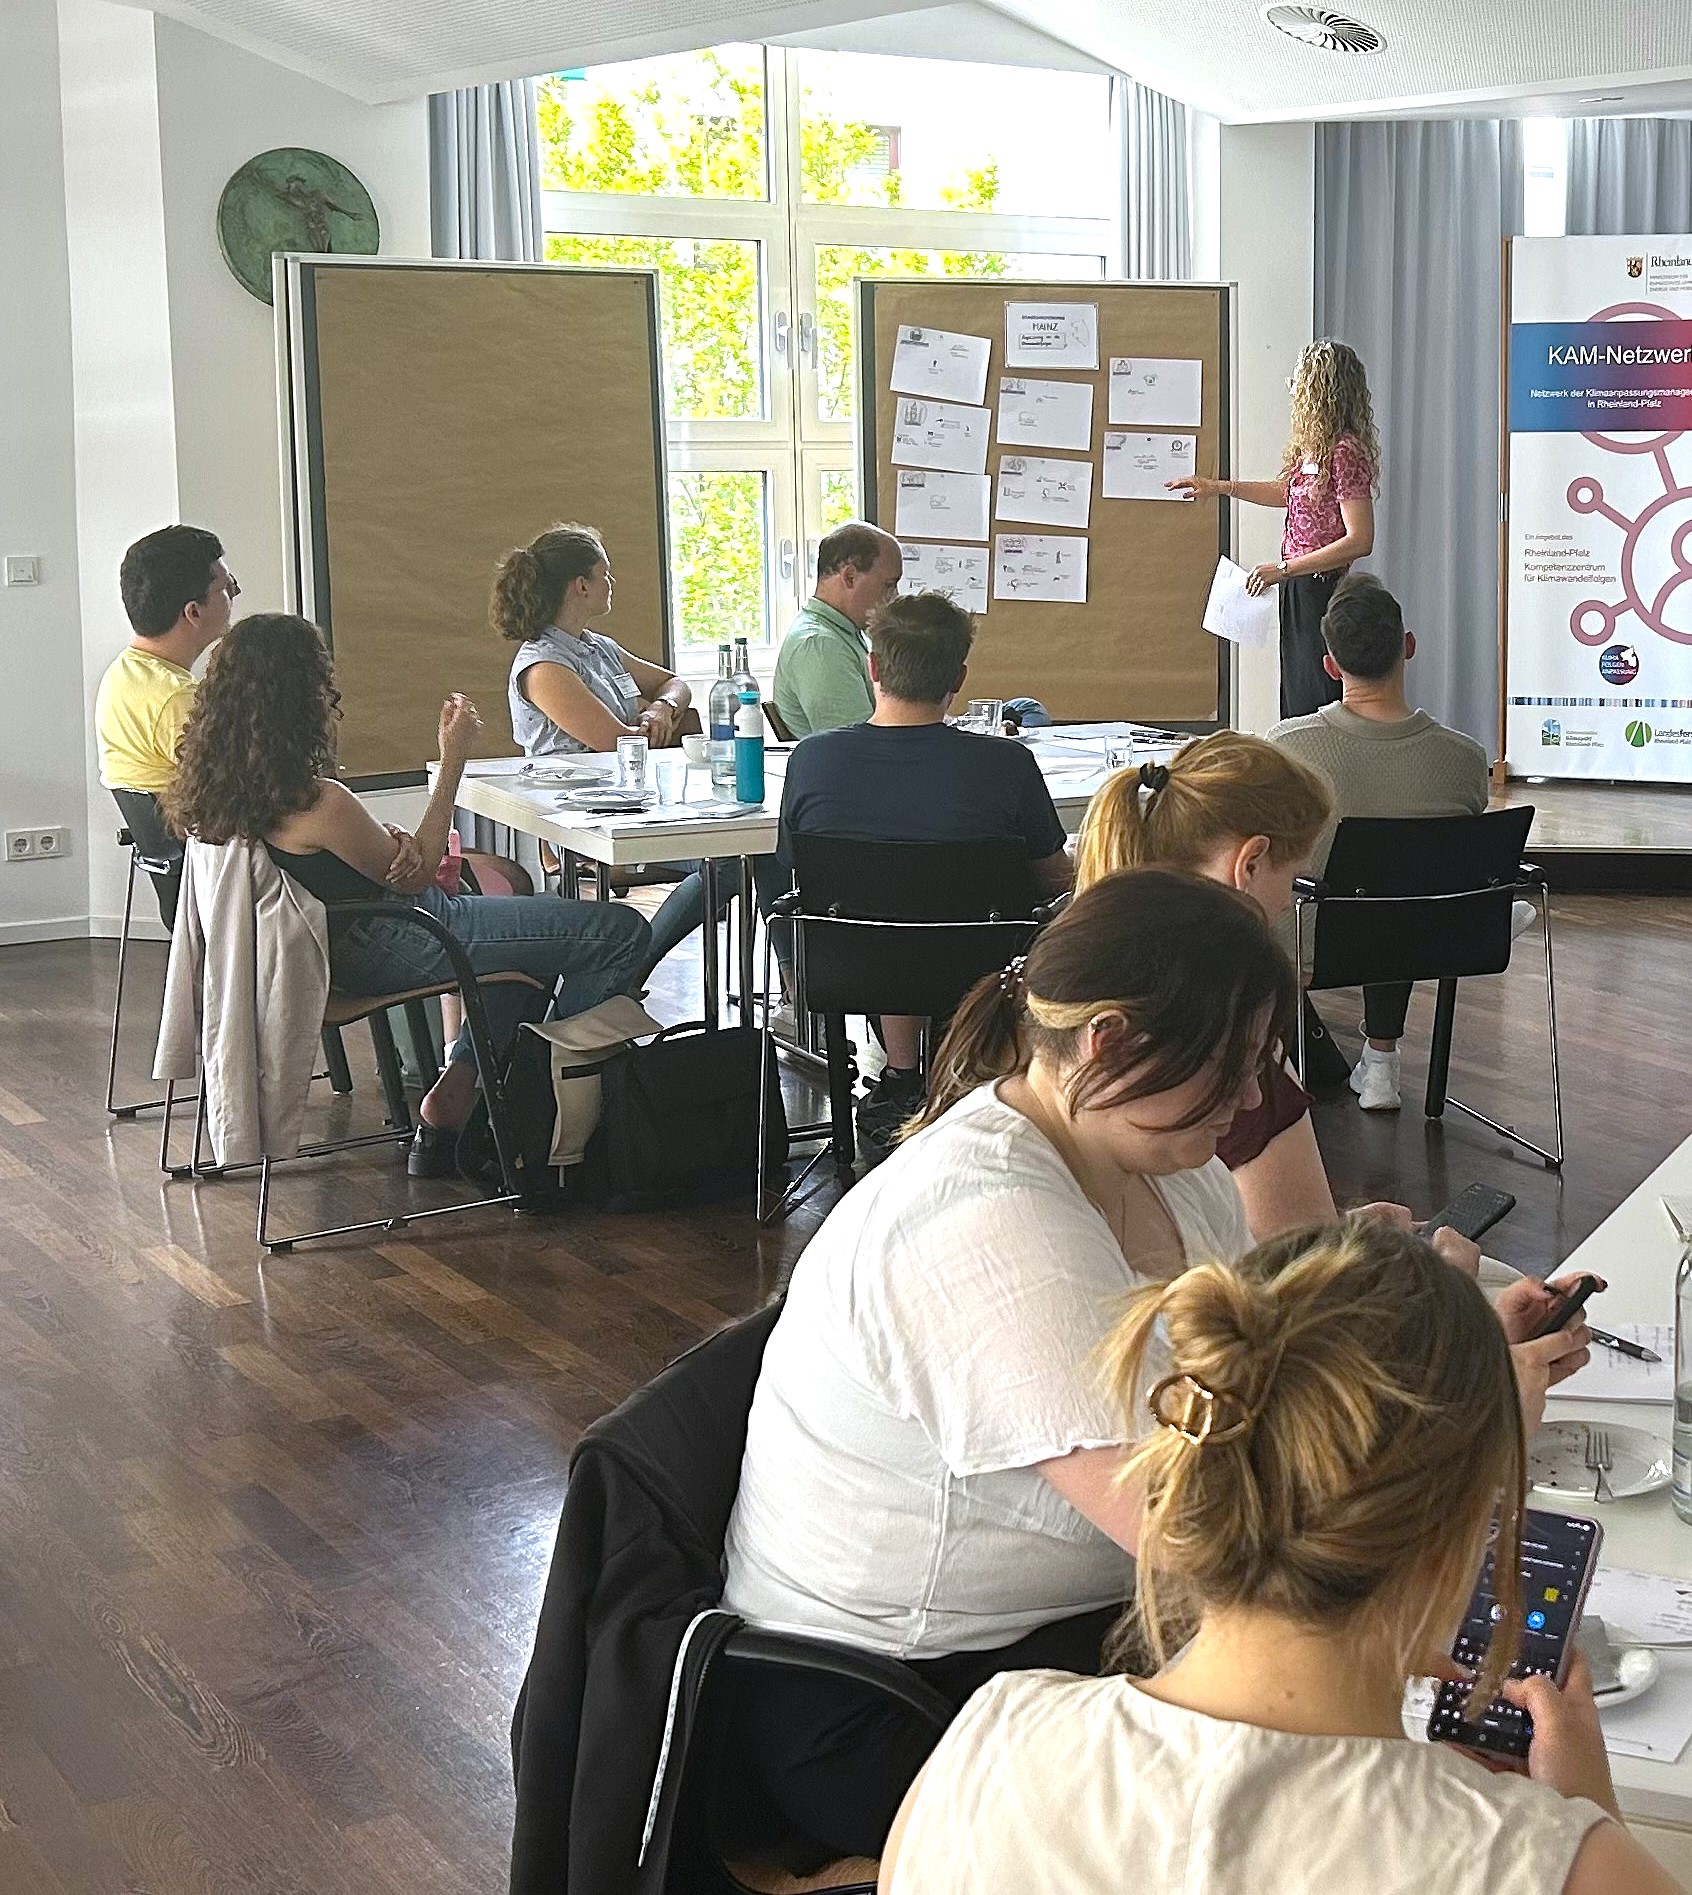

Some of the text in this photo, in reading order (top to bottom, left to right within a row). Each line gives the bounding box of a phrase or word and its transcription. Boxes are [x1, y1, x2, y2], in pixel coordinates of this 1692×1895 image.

[1032, 322, 1059, 331] MAINZ
[1530, 389, 1568, 398] Netzwerk
[1570, 389, 1585, 398] der
[1587, 399, 1662, 409] in Rheinland-Pfalz
[1524, 548, 1591, 557] Rheinland-Pfalz
